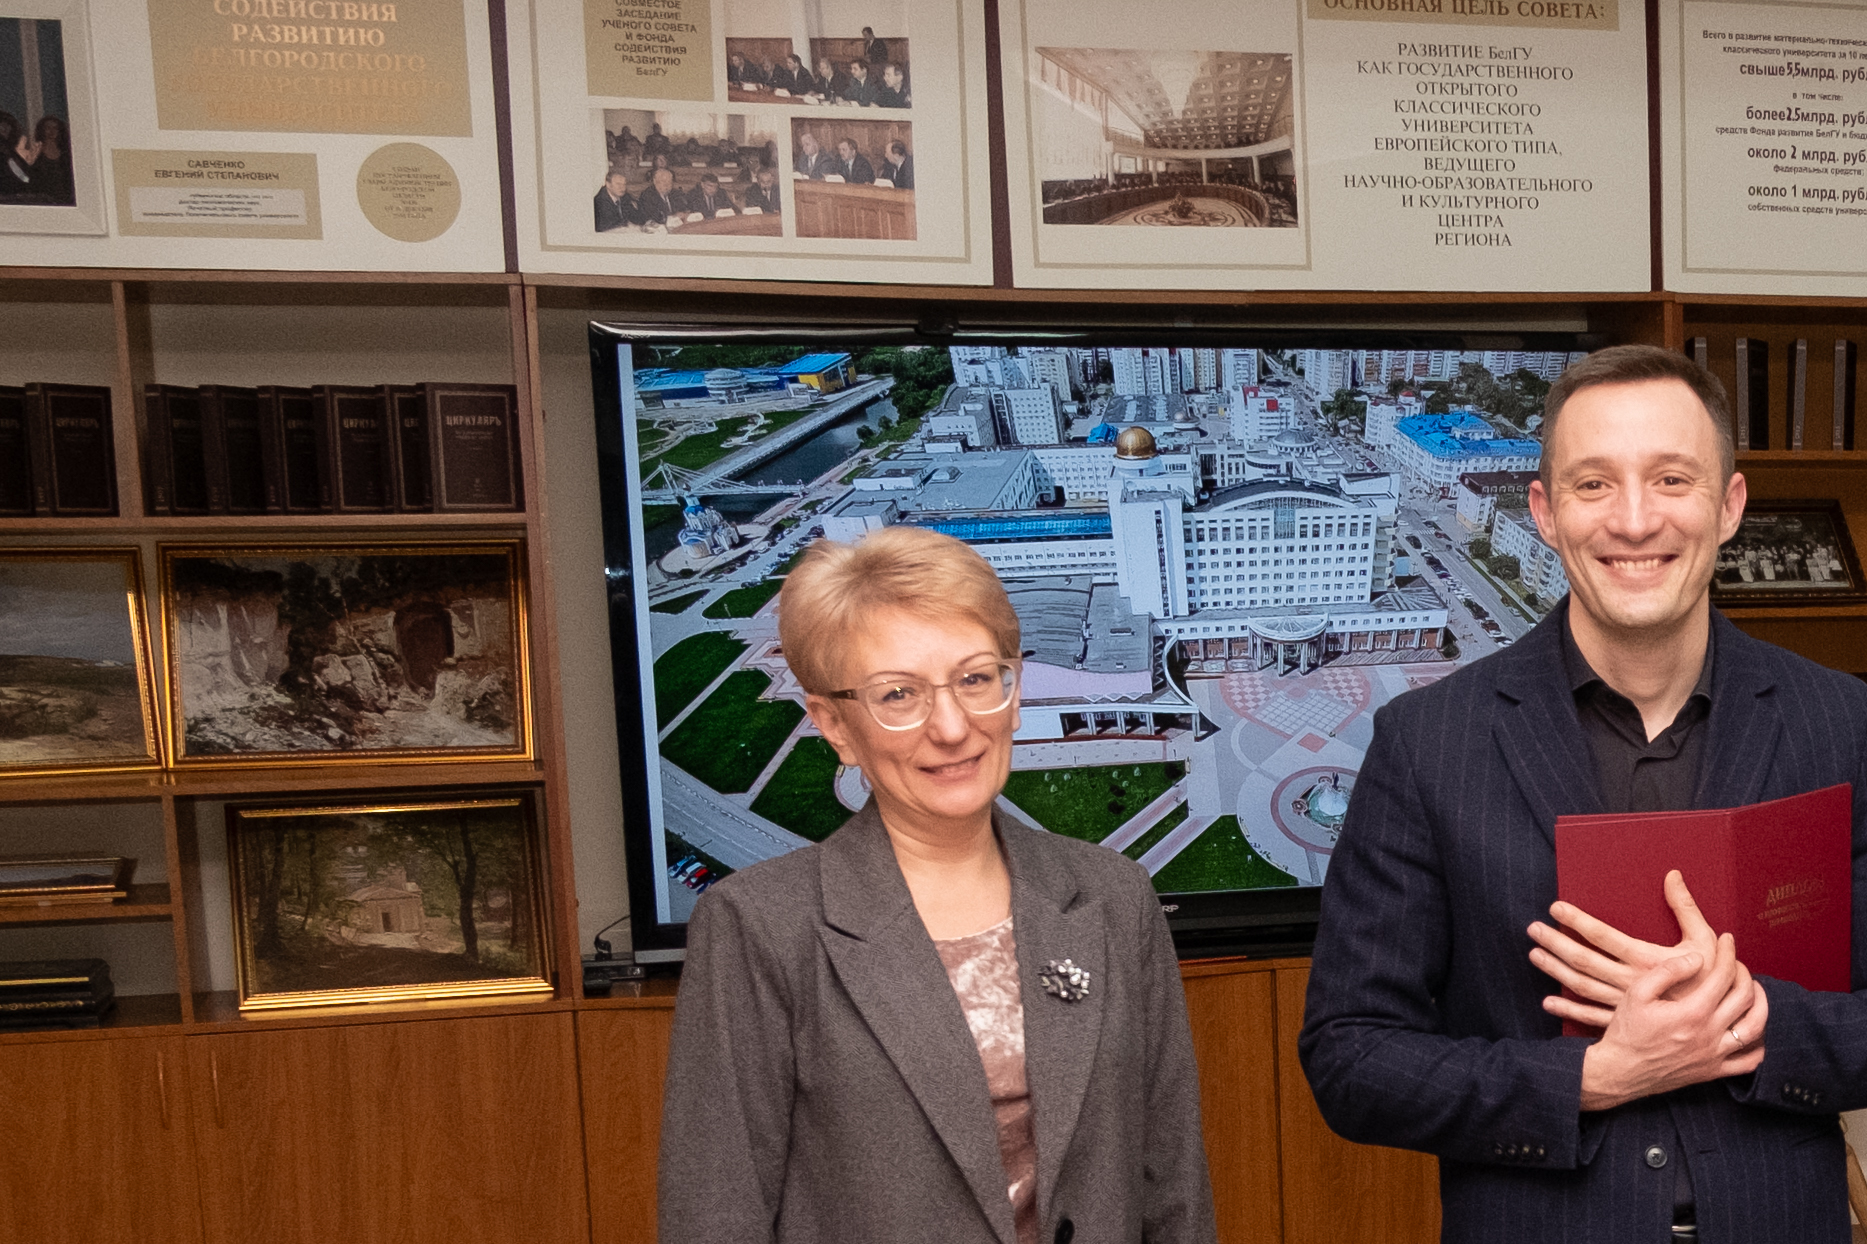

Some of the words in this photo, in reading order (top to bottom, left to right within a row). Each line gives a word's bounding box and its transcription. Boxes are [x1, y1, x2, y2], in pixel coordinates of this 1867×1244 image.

[616, 9, 682, 20] ЗАСЕДАНИЕ
[1325, 0, 1443, 13] ОСНОВНАЯ
[1452, 0, 1510, 17] ЦЕЛЬ
[1517, 0, 1605, 20] СОВЕТА:
[602, 19, 652, 30] УЧЕНОГО
[655, 22, 697, 33] СОВЕТА
[232, 23, 386, 47] РАЗВИТИЮ
[625, 31, 633, 40] И
[636, 33, 675, 43] ФОНДА
[1702, 30, 1726, 41] Всего
[615, 42, 687, 55] СОДЕЙСТВИЯ
[1397, 42, 1484, 59] РАЗВИТИЕ
[1489, 46, 1533, 61] БелГУ
[622, 55, 681, 66] РАЗВИТИЮ
[1357, 60, 1394, 75] КАК
[1398, 62, 1574, 80] ГОСУДАРСТВЕННОГО
[1416, 81, 1518, 97] ОТКРЫТОГО
[1393, 99, 1541, 117] КЛАССИЧЕСКОГО
[1401, 118, 1534, 135] УНИВЕРСИТЕТА
[1374, 135, 1508, 153] ЕВРОПЕЙСКОГО
[1512, 139, 1563, 156] ТИПА,
[1747, 146, 1787, 159] около
[1790, 145, 1797, 159] 2
[1801, 149, 1839, 164] млрд.
[188, 159, 245, 169] САВЧЕНКО
[1423, 157, 1516, 173] ВЕДУЩЕГО
[1344, 174, 1594, 193] НАУЧНО-ОБРАЗОВАТЕЛЬНОГО
[1748, 184, 1787, 197] около
[1792, 184, 1797, 197] 1
[1802, 187, 1839, 202] млрд.
[1401, 194, 1414, 209] И
[1419, 194, 1540, 211] КУЛЬТУРНОГО
[1438, 213, 1505, 229] ЦЕНТРА
[1435, 232, 1513, 247] РЕГИОНА
